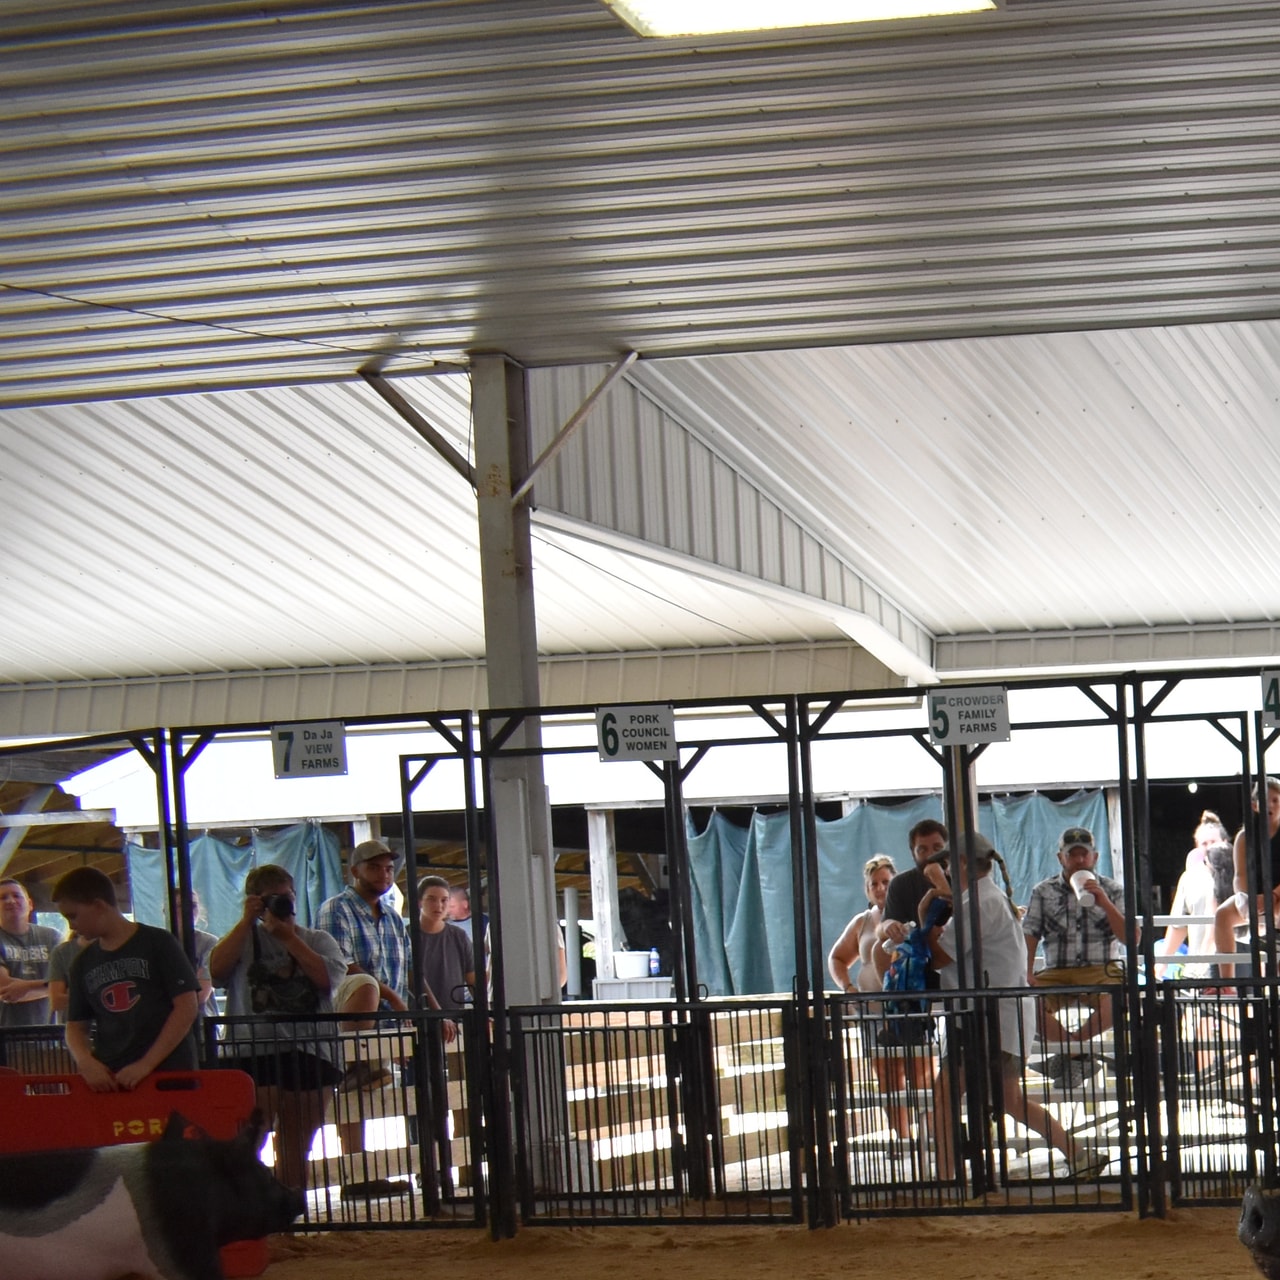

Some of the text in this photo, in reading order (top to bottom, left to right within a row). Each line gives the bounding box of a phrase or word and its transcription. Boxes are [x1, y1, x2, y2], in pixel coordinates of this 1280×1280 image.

[948, 695, 1004, 707] CROWDER
[630, 714, 659, 724] PORK
[932, 696, 949, 739] 5
[958, 709, 996, 720] FAMILY
[622, 728, 670, 738] COUNCIL
[960, 722, 997, 734] FARMS
[303, 729, 333, 740] Da Ja
[602, 713, 619, 756] 6
[278, 731, 294, 772] 7
[305, 743, 333, 754] VIEW
[626, 741, 667, 751] WOMEN
[301, 758, 339, 770] FARMS
[112, 1118, 169, 1137] POR
